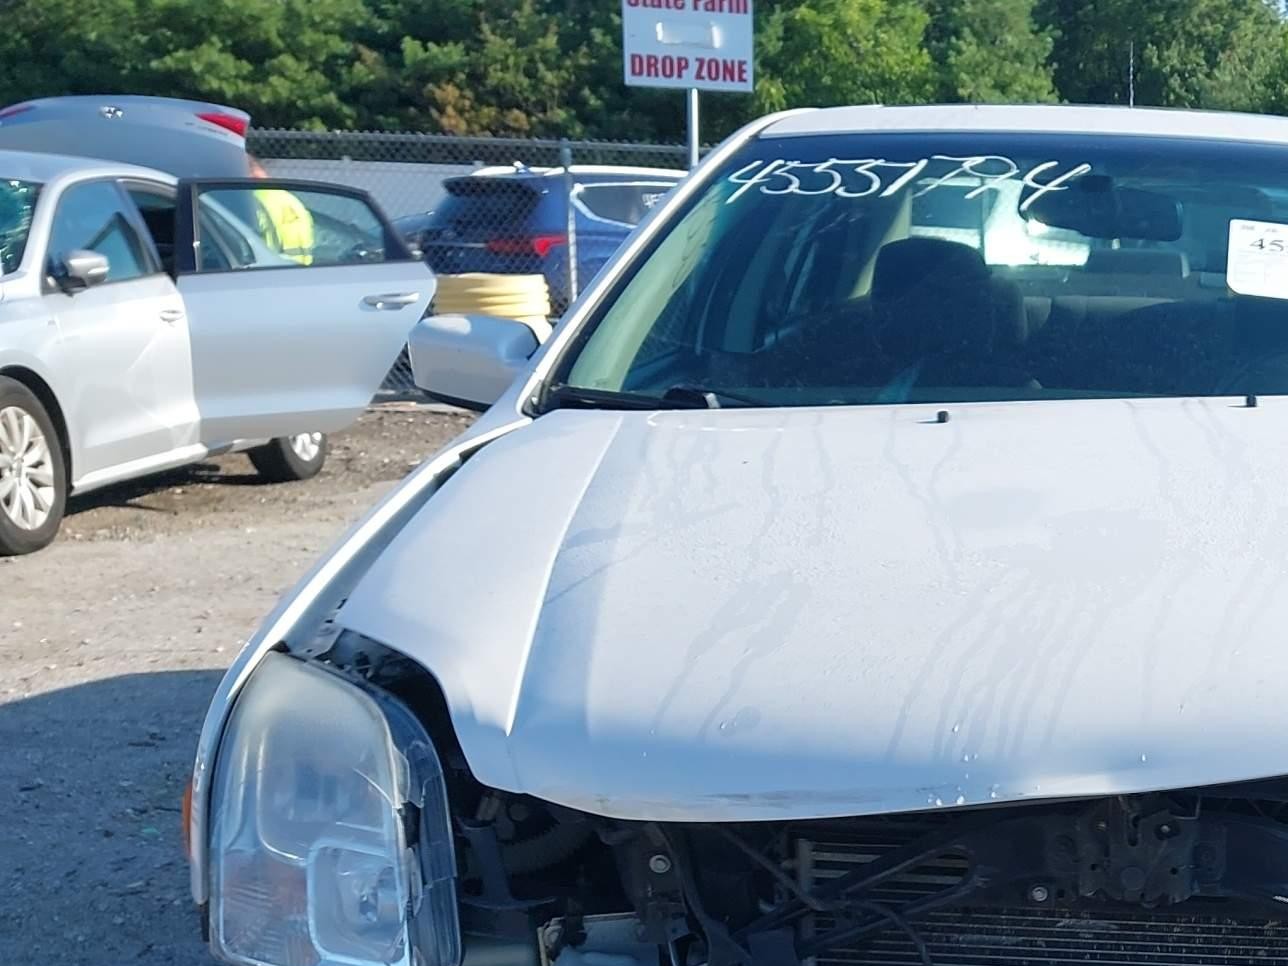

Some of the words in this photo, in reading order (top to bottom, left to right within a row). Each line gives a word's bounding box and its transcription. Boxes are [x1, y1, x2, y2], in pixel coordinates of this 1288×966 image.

[630, 53, 689, 78] DROP
[695, 57, 747, 82] ZONE
[725, 154, 1092, 211] 45551794
